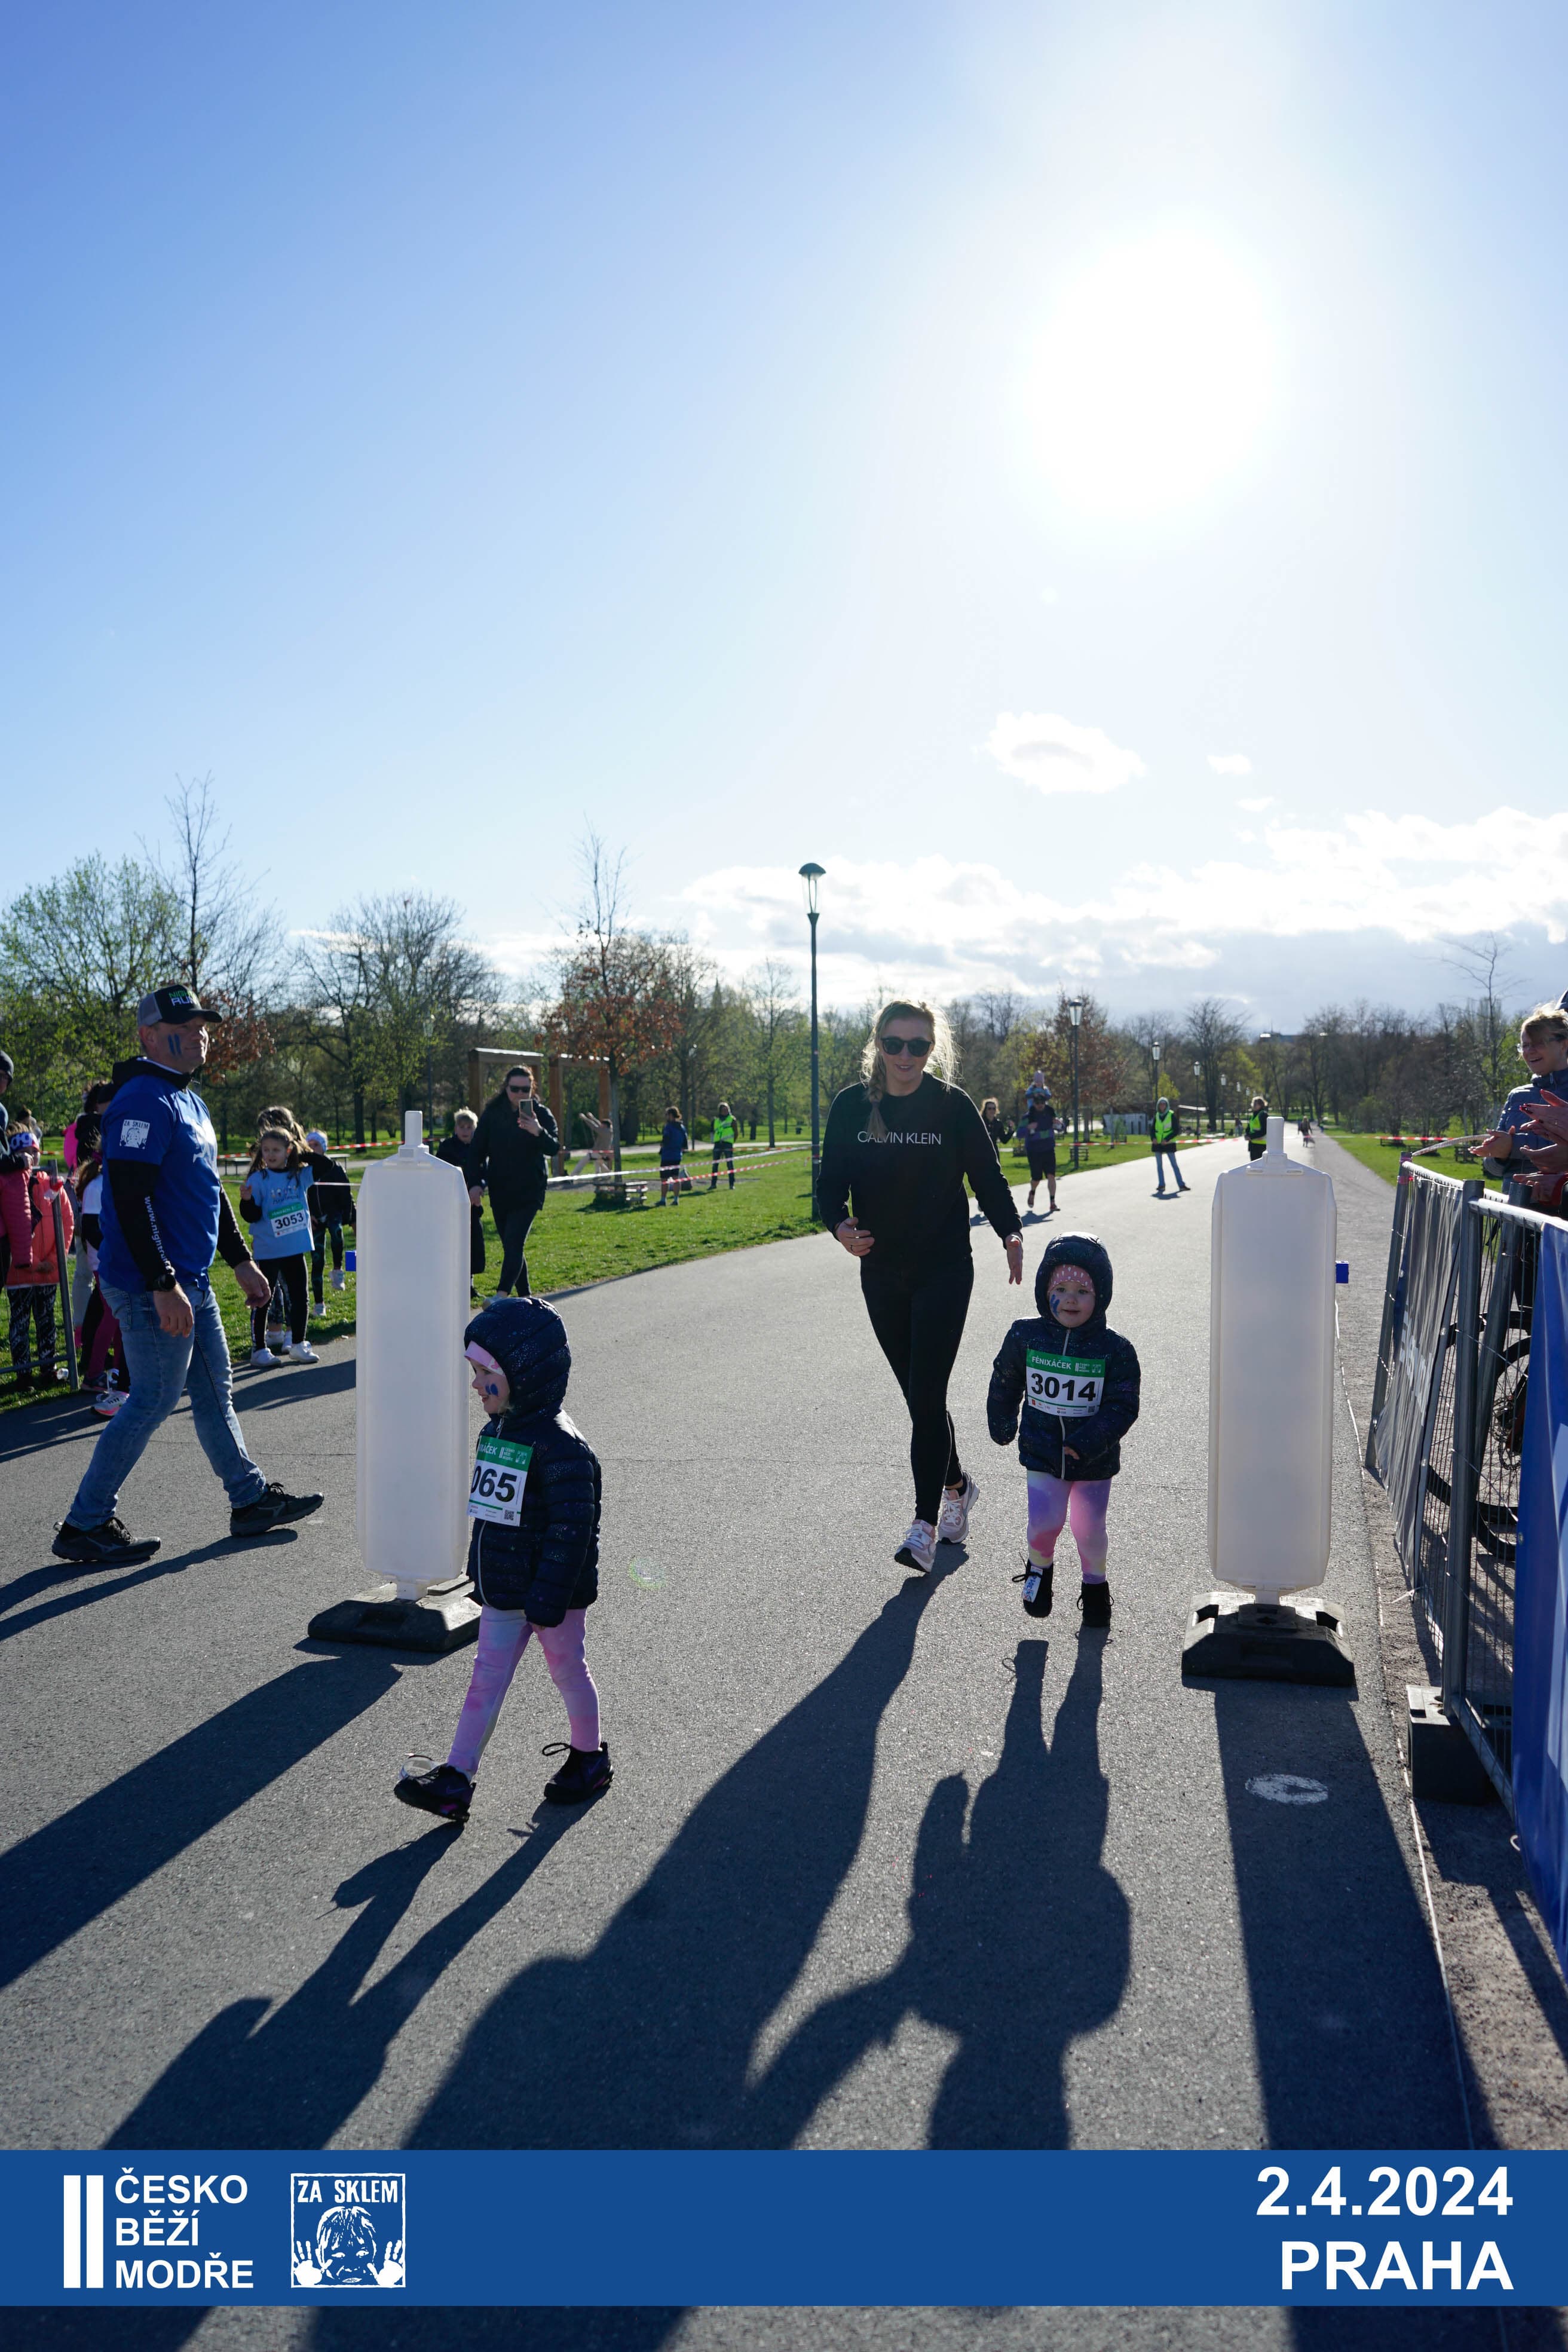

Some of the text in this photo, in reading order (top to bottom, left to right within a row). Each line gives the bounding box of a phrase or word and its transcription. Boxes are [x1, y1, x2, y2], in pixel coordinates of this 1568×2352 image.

[906, 1132, 942, 1145] KLEIN
[274, 1212, 304, 1230] 3053
[1031, 1355, 1072, 1370] FÉNIXÁČEK
[1031, 1373, 1097, 1401] 3014
